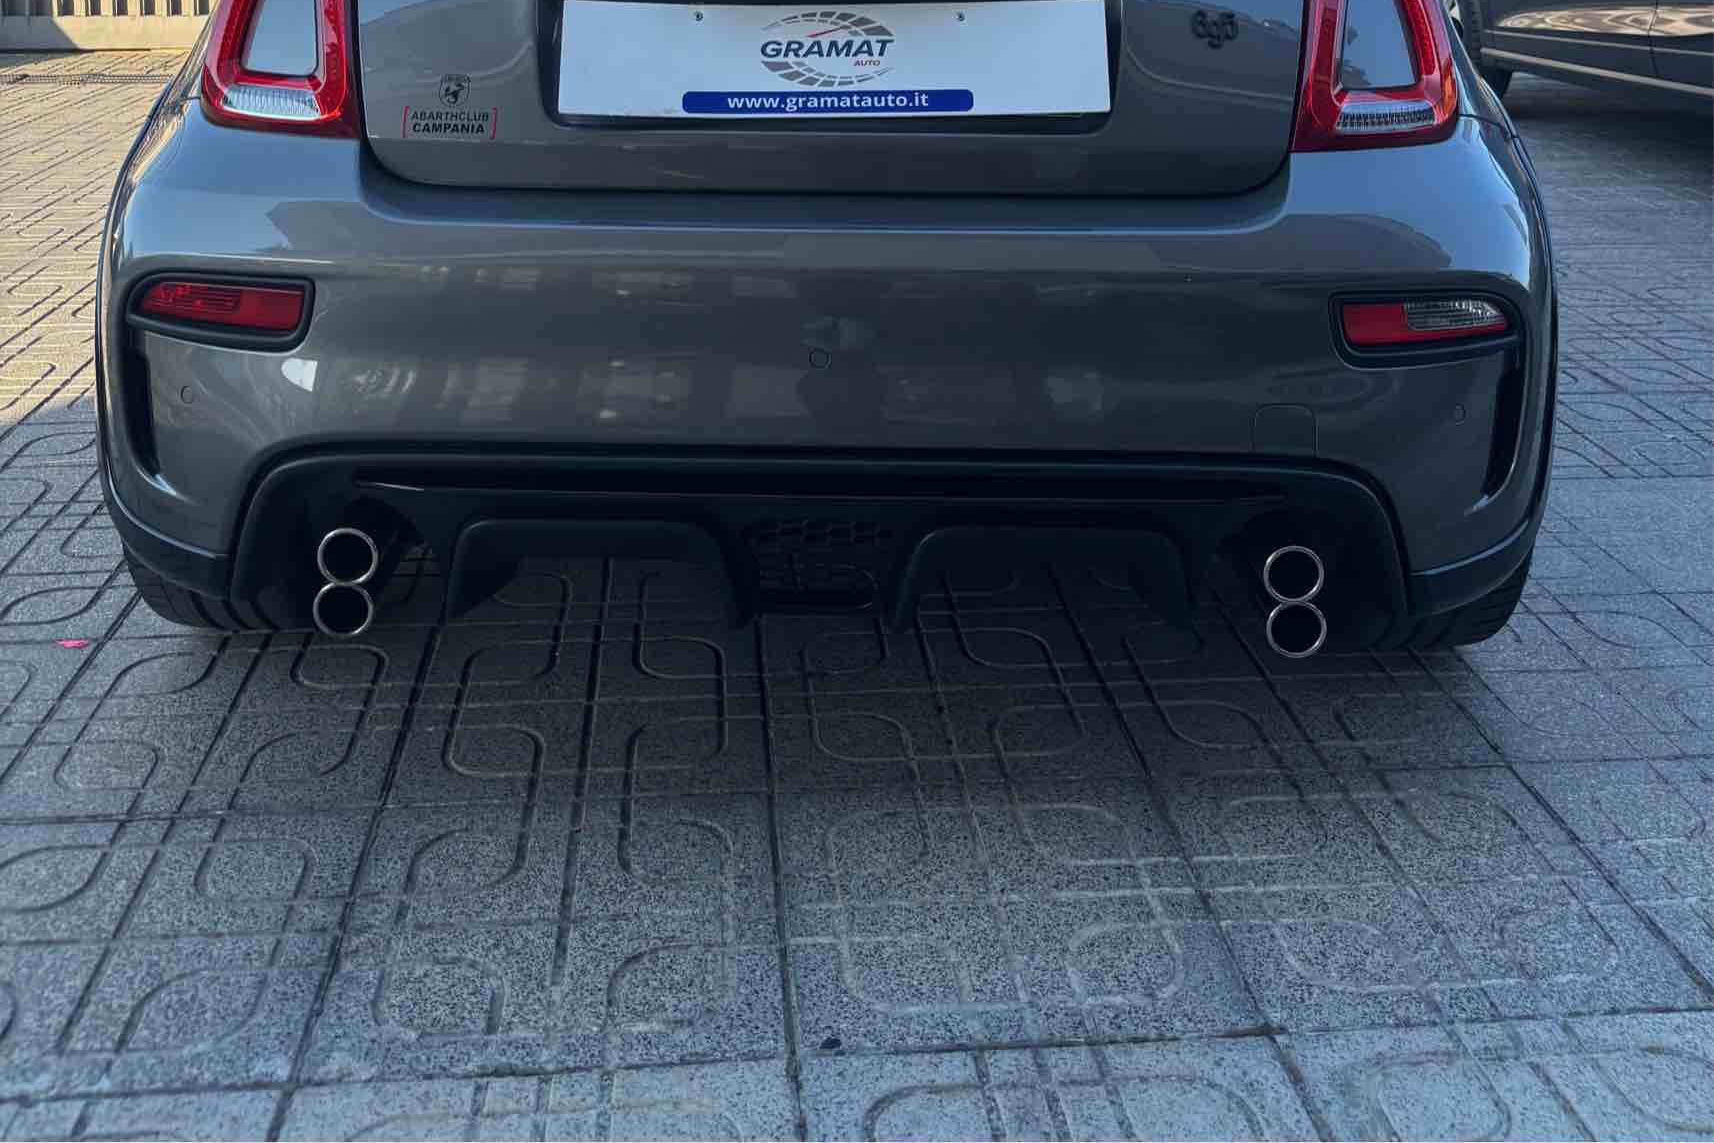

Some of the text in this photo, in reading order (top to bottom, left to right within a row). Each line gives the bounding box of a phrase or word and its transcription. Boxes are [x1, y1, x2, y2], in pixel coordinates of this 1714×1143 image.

[760, 38, 895, 59] GRAMAT
[853, 59, 881, 67] AUTO
[727, 92, 929, 112] www.gramatauto.it
[412, 122, 485, 134] CAMPANIA
